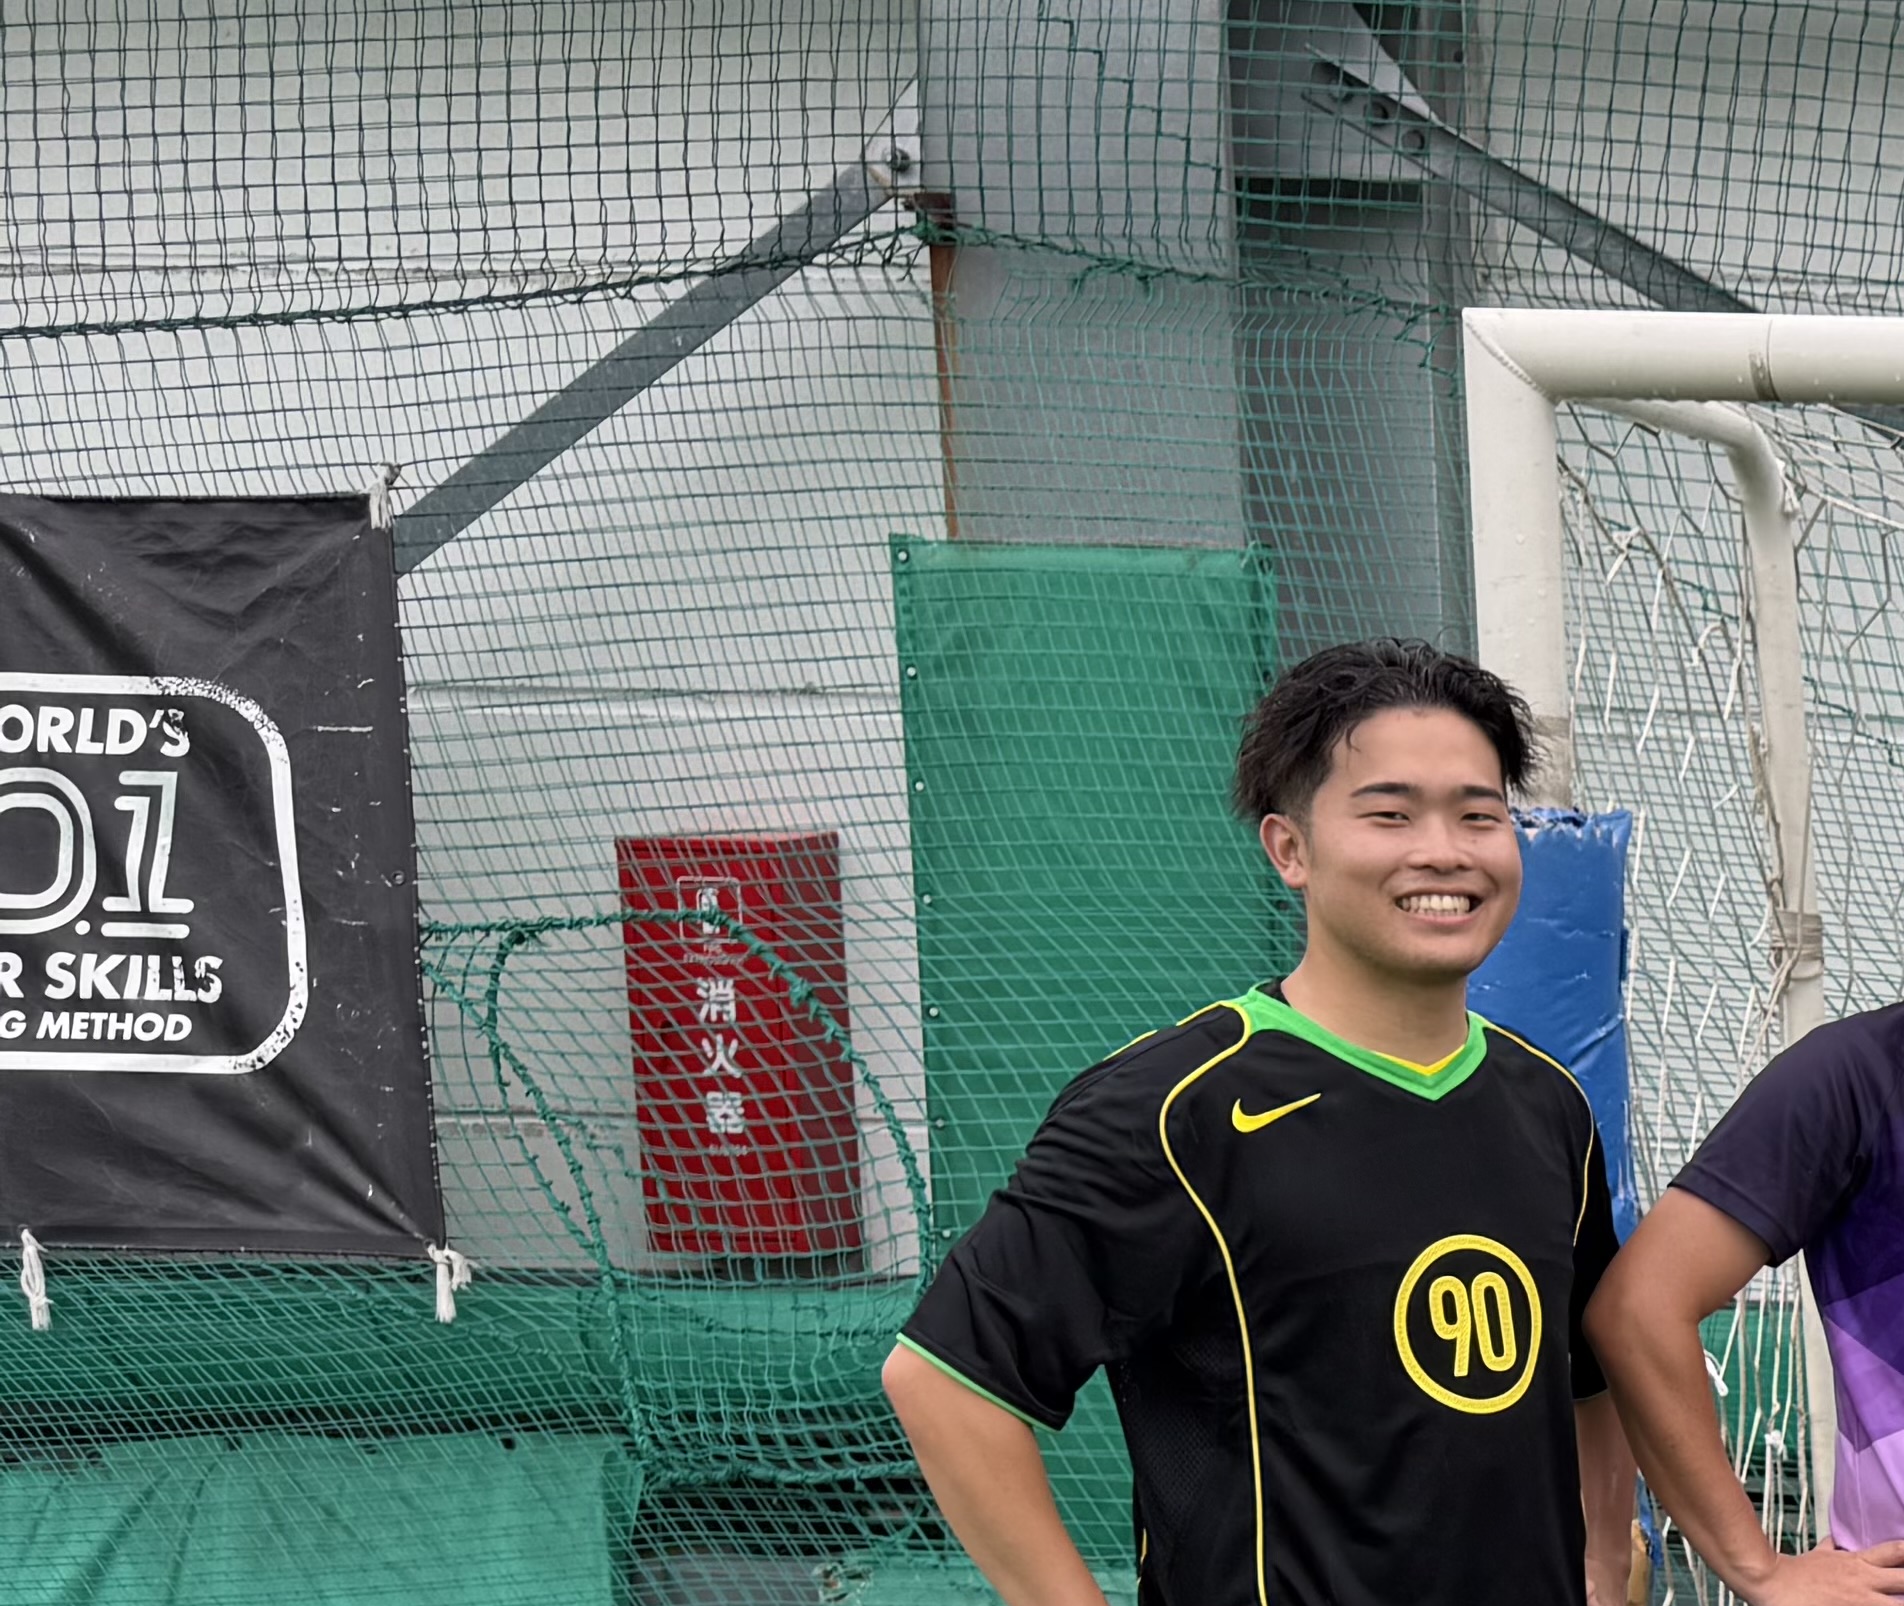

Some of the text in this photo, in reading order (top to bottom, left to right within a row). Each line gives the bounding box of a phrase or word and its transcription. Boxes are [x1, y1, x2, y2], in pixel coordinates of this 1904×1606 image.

[44, 952, 223, 1003] SKILLS
[36, 1011, 192, 1042] METHOD
[697, 977, 745, 1134] 消火器
[1429, 1271, 1517, 1377] 90
